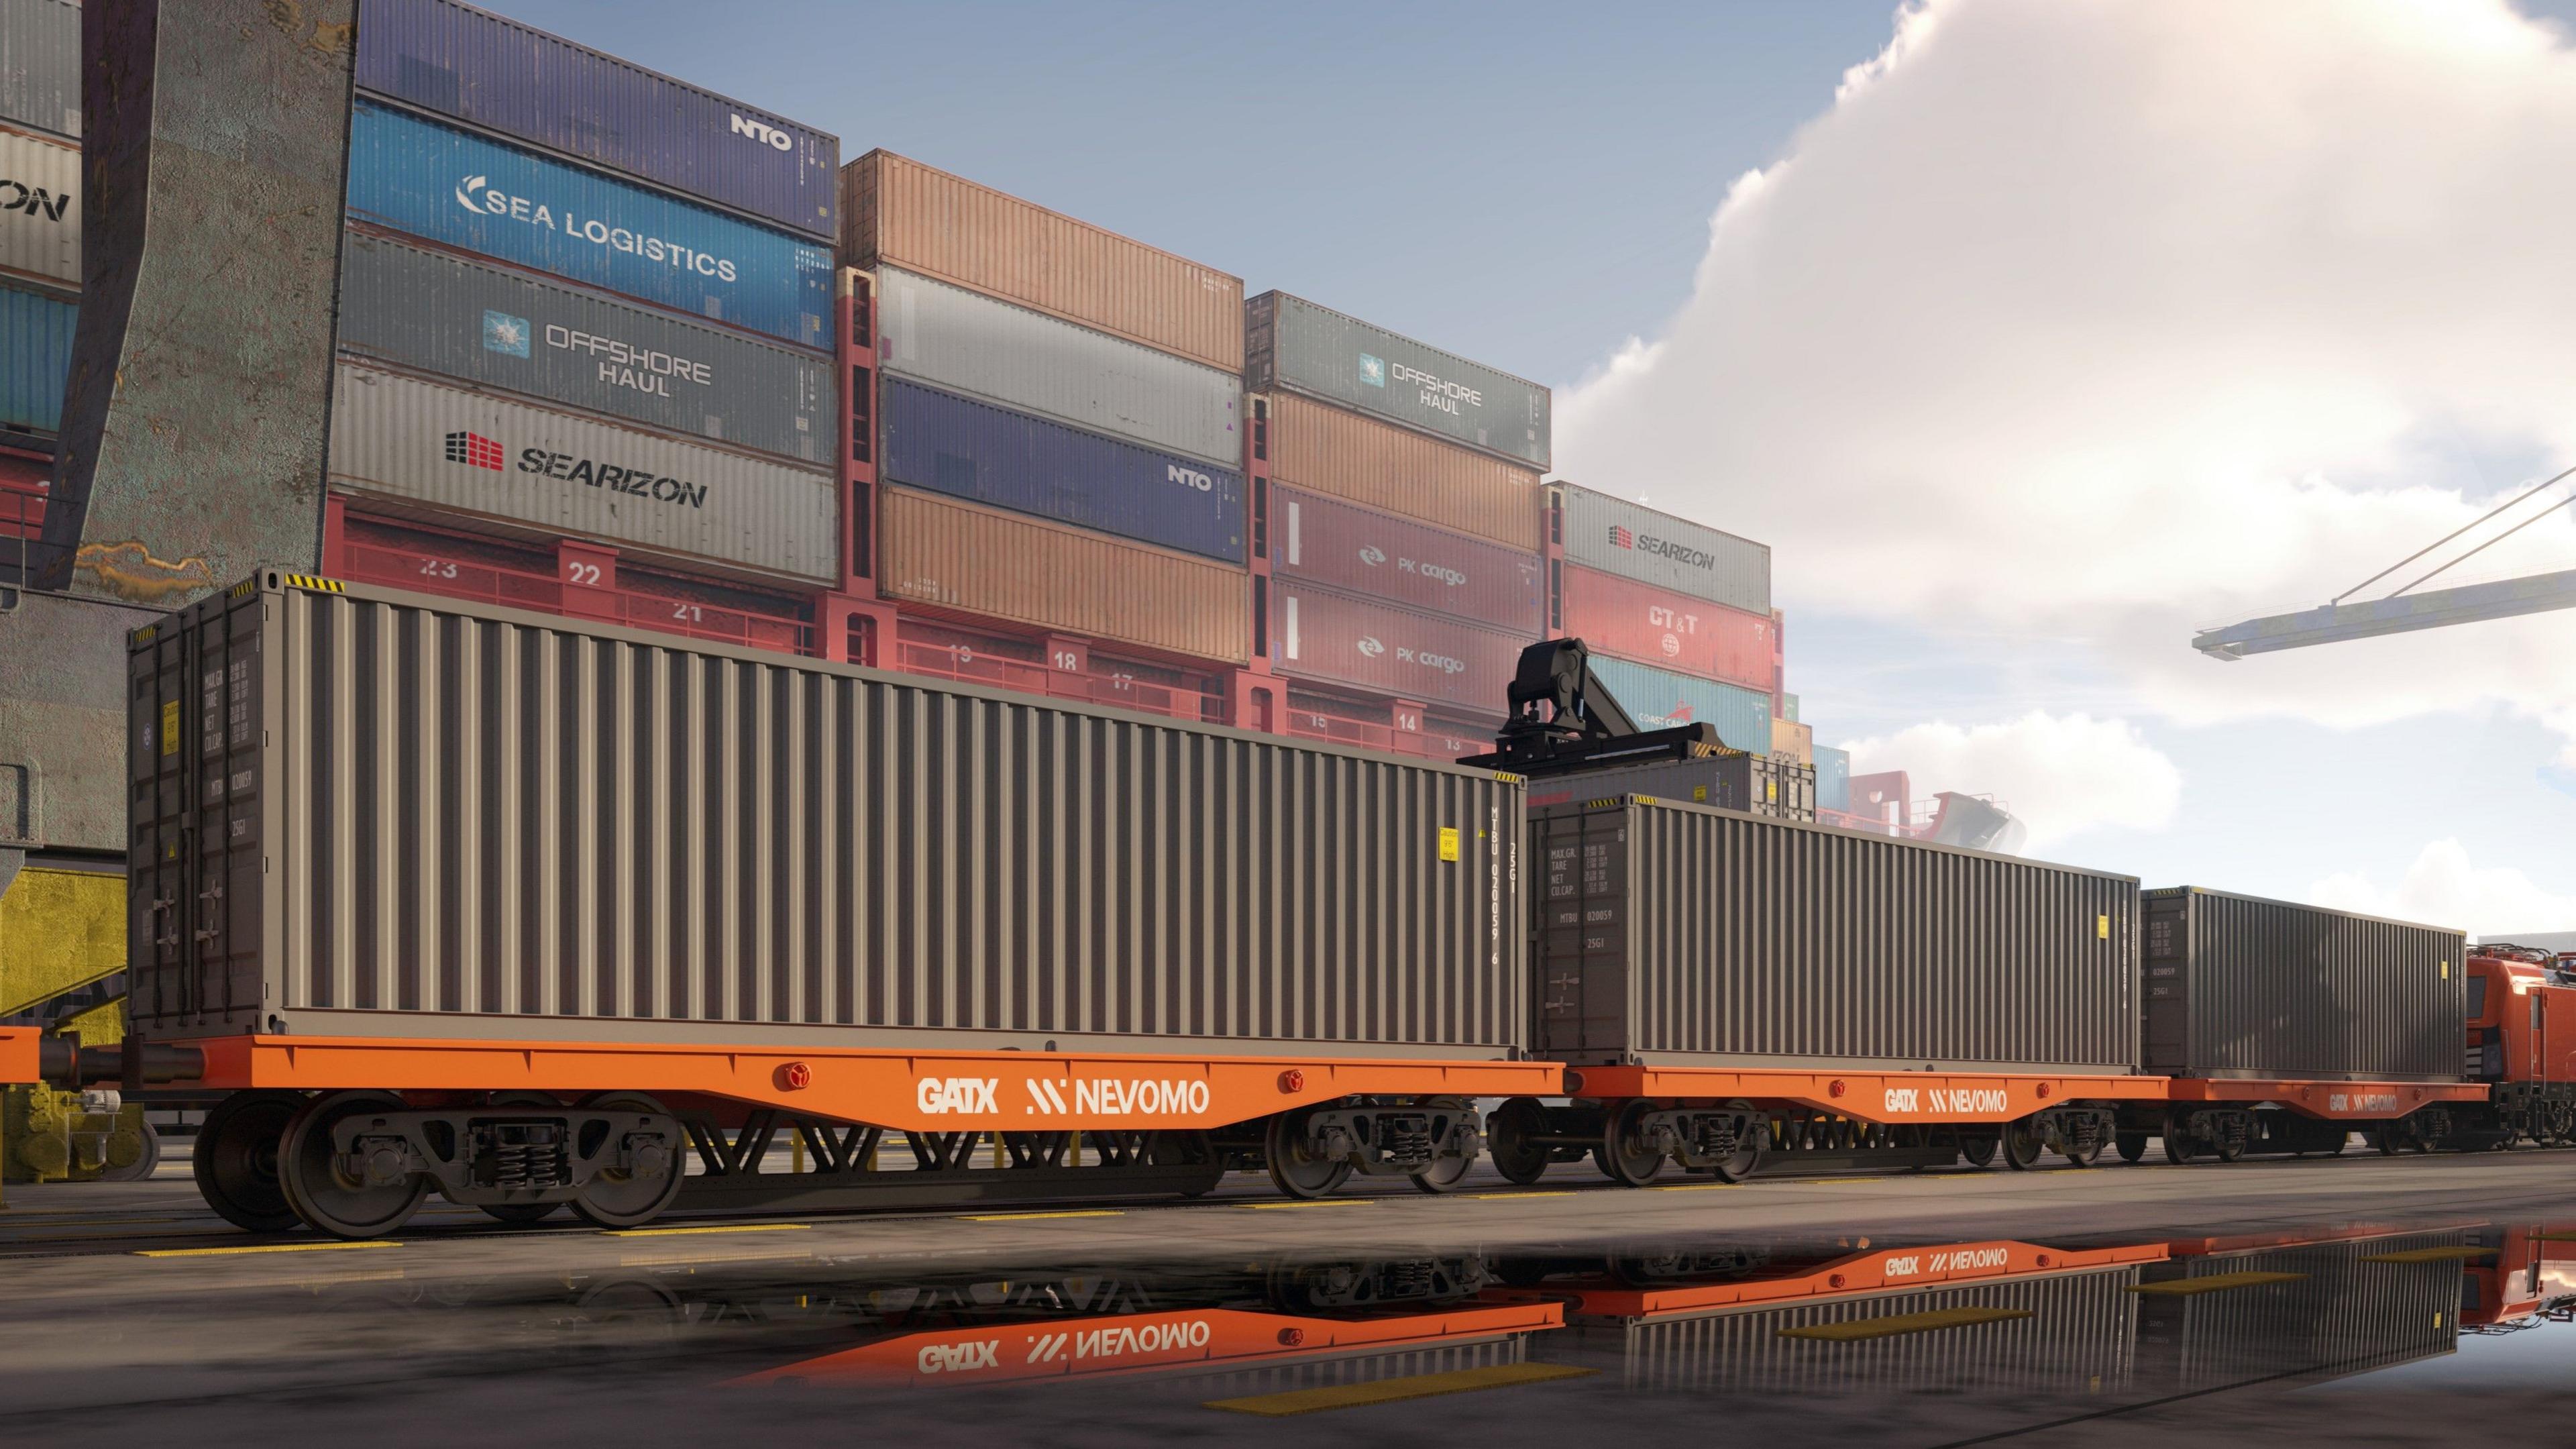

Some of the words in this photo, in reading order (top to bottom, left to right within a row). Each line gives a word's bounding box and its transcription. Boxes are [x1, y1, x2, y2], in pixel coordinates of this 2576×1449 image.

[731, 113, 792, 152] NTO
[0, 180, 71, 223] ON
[486, 189, 556, 229] SEA
[566, 212, 737, 282] LOGISTICS
[545, 324, 712, 386] OFFSHORE
[599, 361, 670, 398] HAUL
[1392, 363, 1482, 407] OFFSHORE
[1420, 391, 1459, 416] HAUL
[517, 447, 708, 508] SEARIZON
[1167, 464, 1212, 491] NTO
[1638, 535, 1715, 570] SEARIZON
[569, 561, 600, 586] 22
[1399, 557, 1415, 574] PK
[1421, 563, 1466, 586] cargo
[672, 603, 701, 622] 21
[1055, 651, 1076, 671] 18
[1397, 647, 1414, 663] PK
[1419, 651, 1464, 673] cargo
[205, 714, 215, 732] NET
[1399, 713, 1415, 731] 14
[1639, 712, 1664, 725] COAST
[231, 770, 252, 791] 020059
[1552, 860, 1567, 871] TARE
[1551, 874, 1564, 884] NET
[1560, 912, 1577, 924] MTBU
[1587, 910, 1613, 921] 020059
[1491, 953, 1498, 965] 6
[917, 1077, 999, 1114] GATX
[1075, 1079, 1210, 1114] NEVOMO
[1885, 1089, 1919, 1112] GATX
[1949, 1089, 2007, 1112] NEVOMO
[2330, 1094, 2348, 1111] GATX
[2365, 1094, 2397, 1111] NEVOMO
